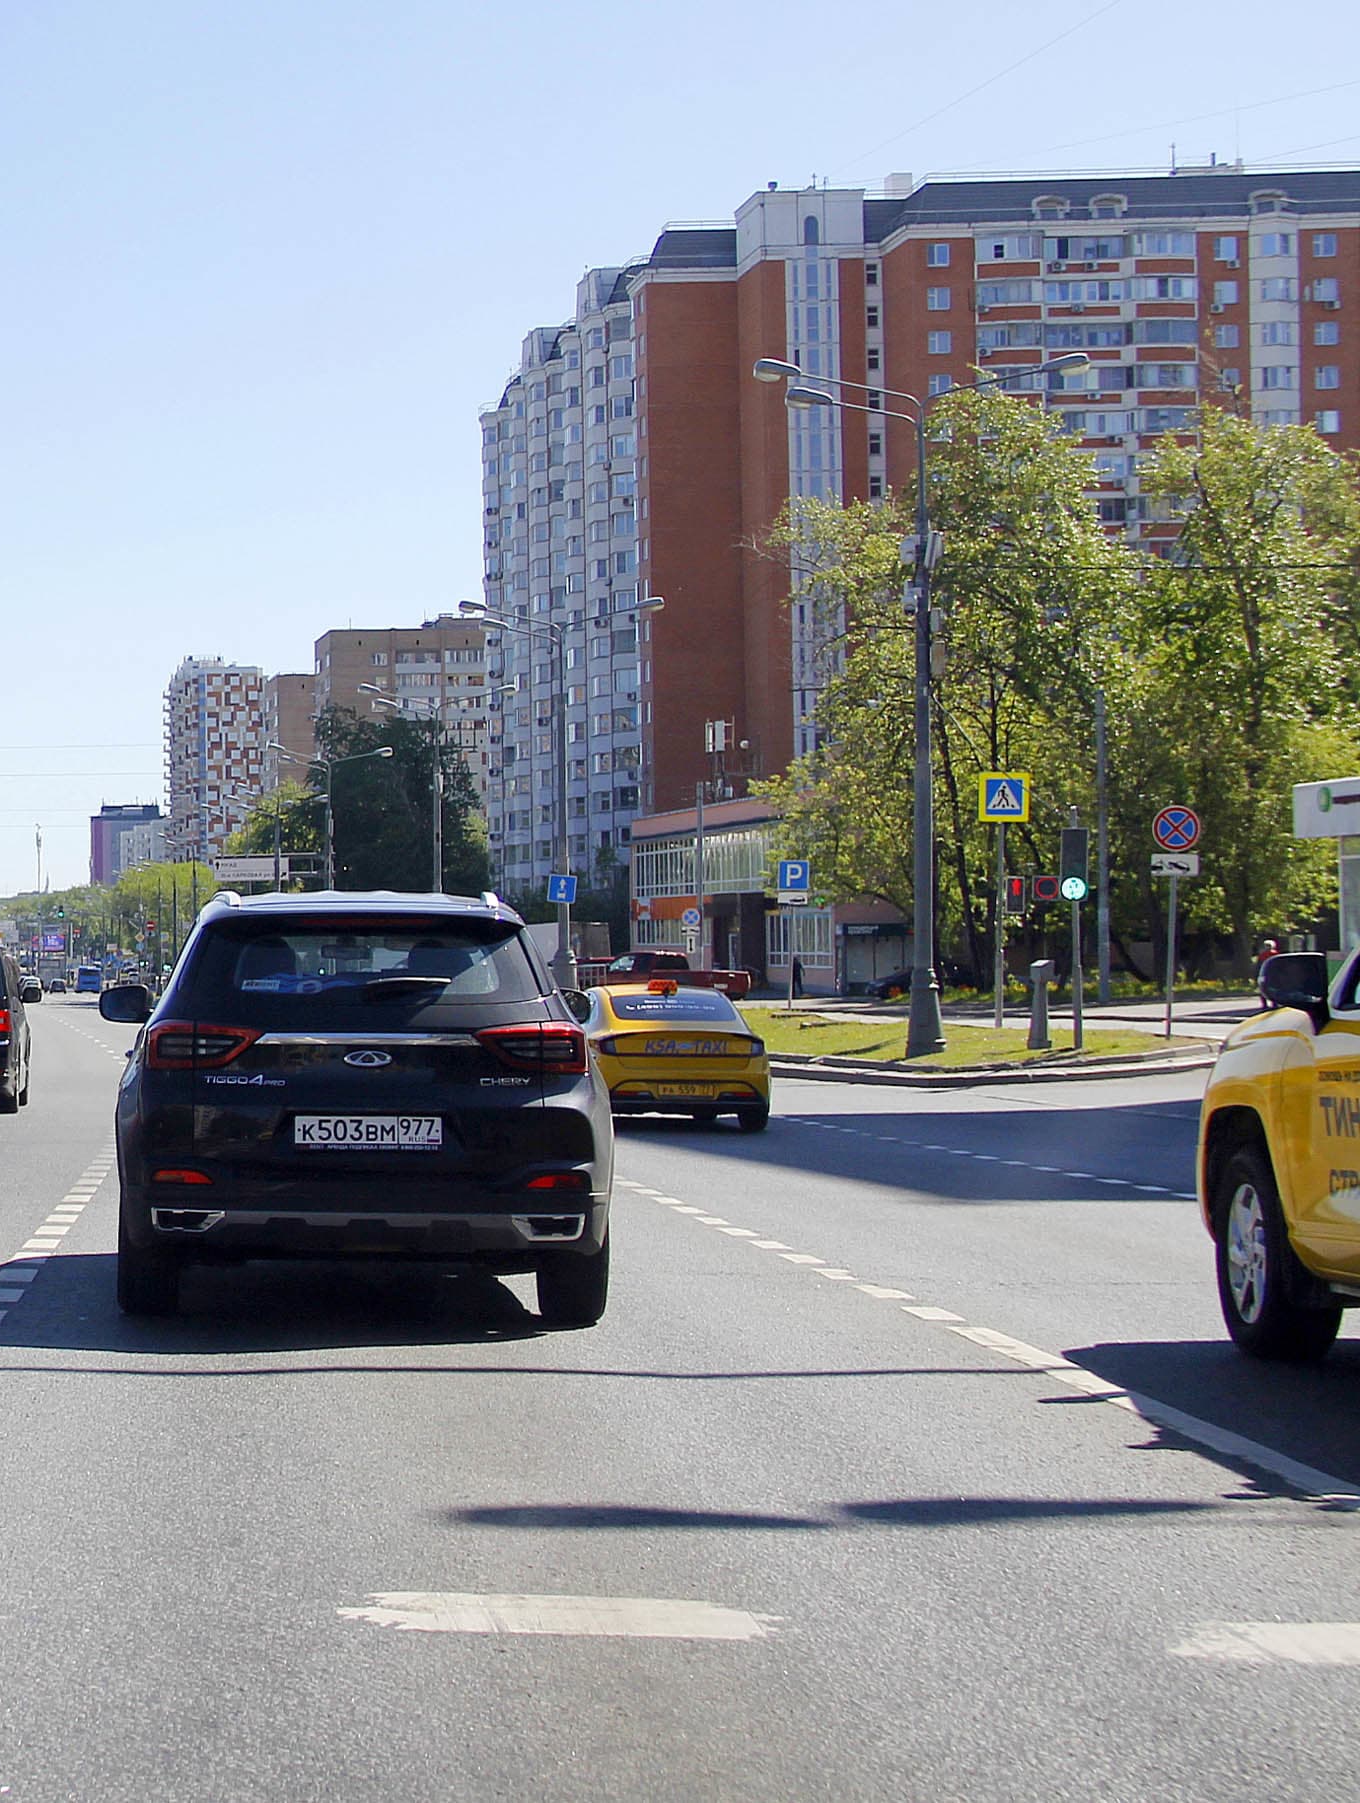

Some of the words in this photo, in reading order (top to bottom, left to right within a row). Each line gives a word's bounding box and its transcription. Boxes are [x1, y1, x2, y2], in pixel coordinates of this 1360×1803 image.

[787, 864, 802, 887] P
[480, 1077, 530, 1086] CHERY
[399, 1118, 435, 1136] 977
